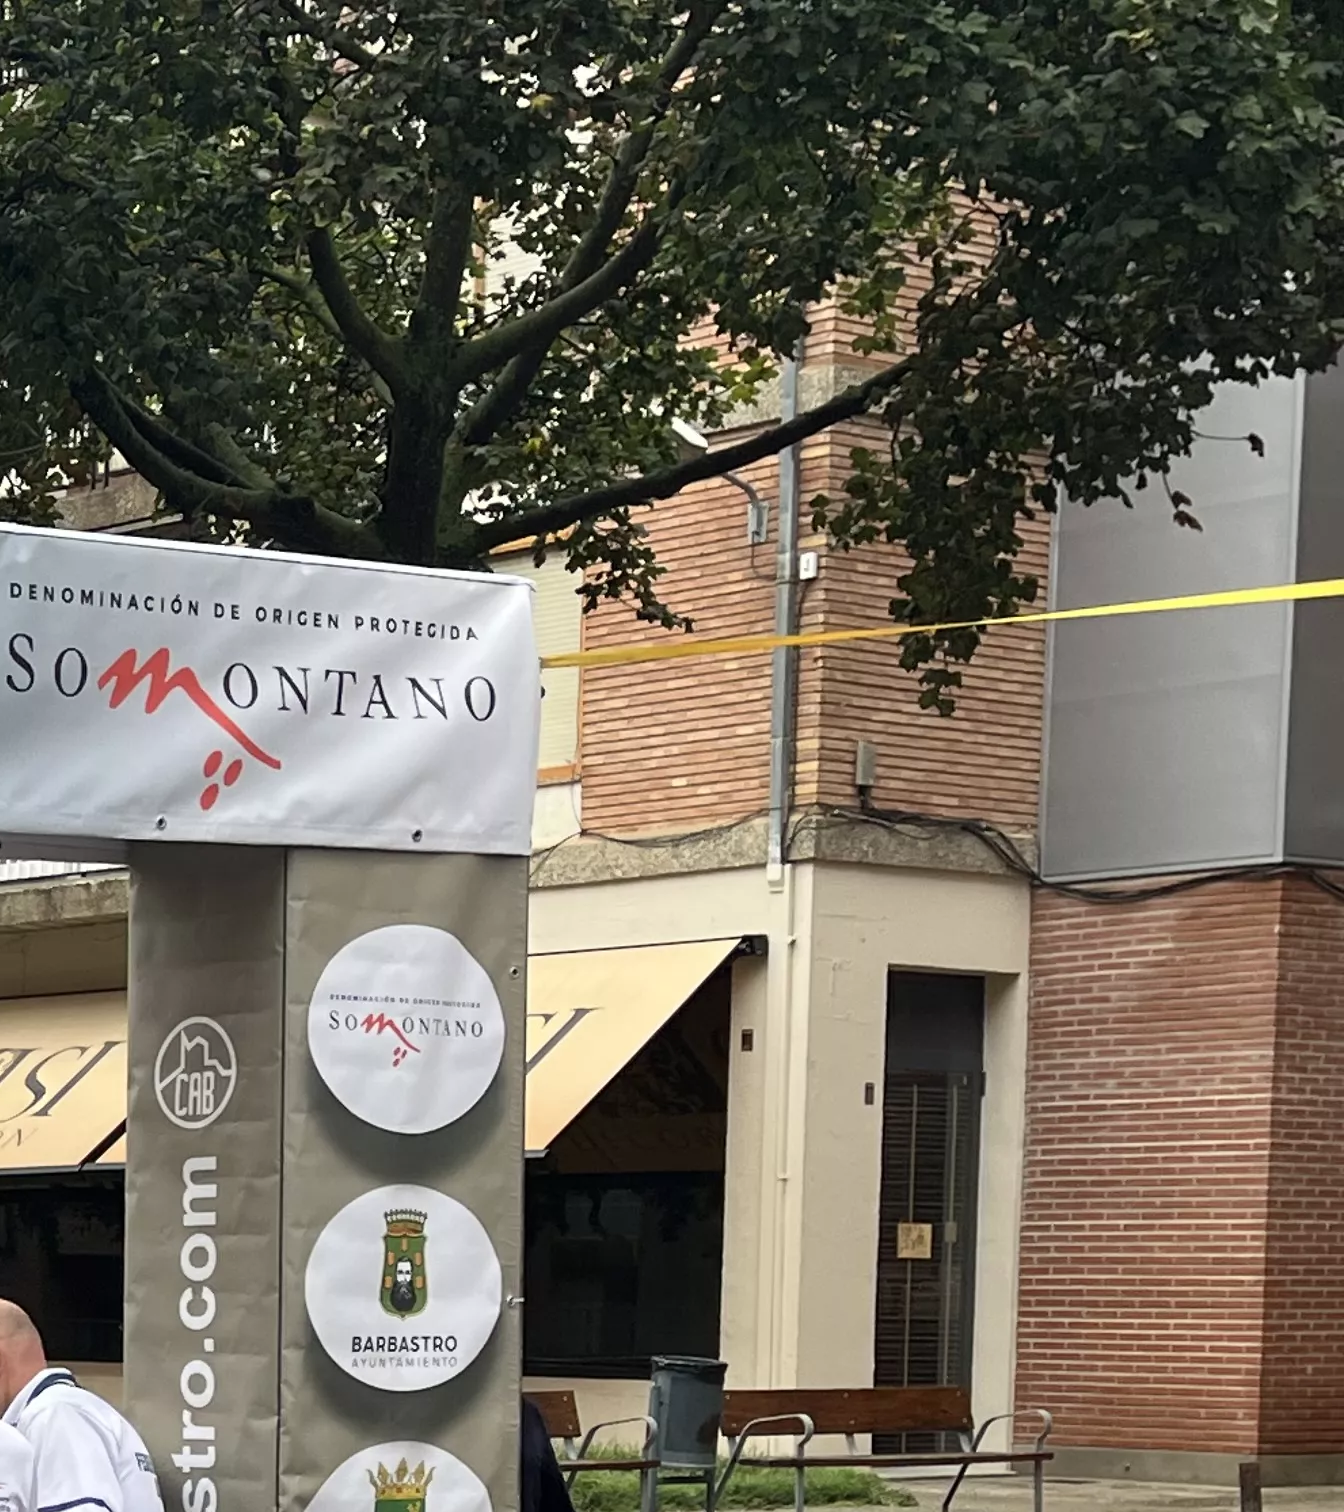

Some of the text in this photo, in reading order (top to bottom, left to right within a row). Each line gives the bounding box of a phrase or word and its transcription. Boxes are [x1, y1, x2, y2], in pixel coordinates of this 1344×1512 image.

[9, 581, 479, 642] DENOMINACIÓN DE ORIGEN PROTEGIDA
[174, 1071, 215, 1117] CAB
[351, 1335, 458, 1353] BARBASTRO
[351, 1356, 458, 1369] AYUNTAMIENTO
